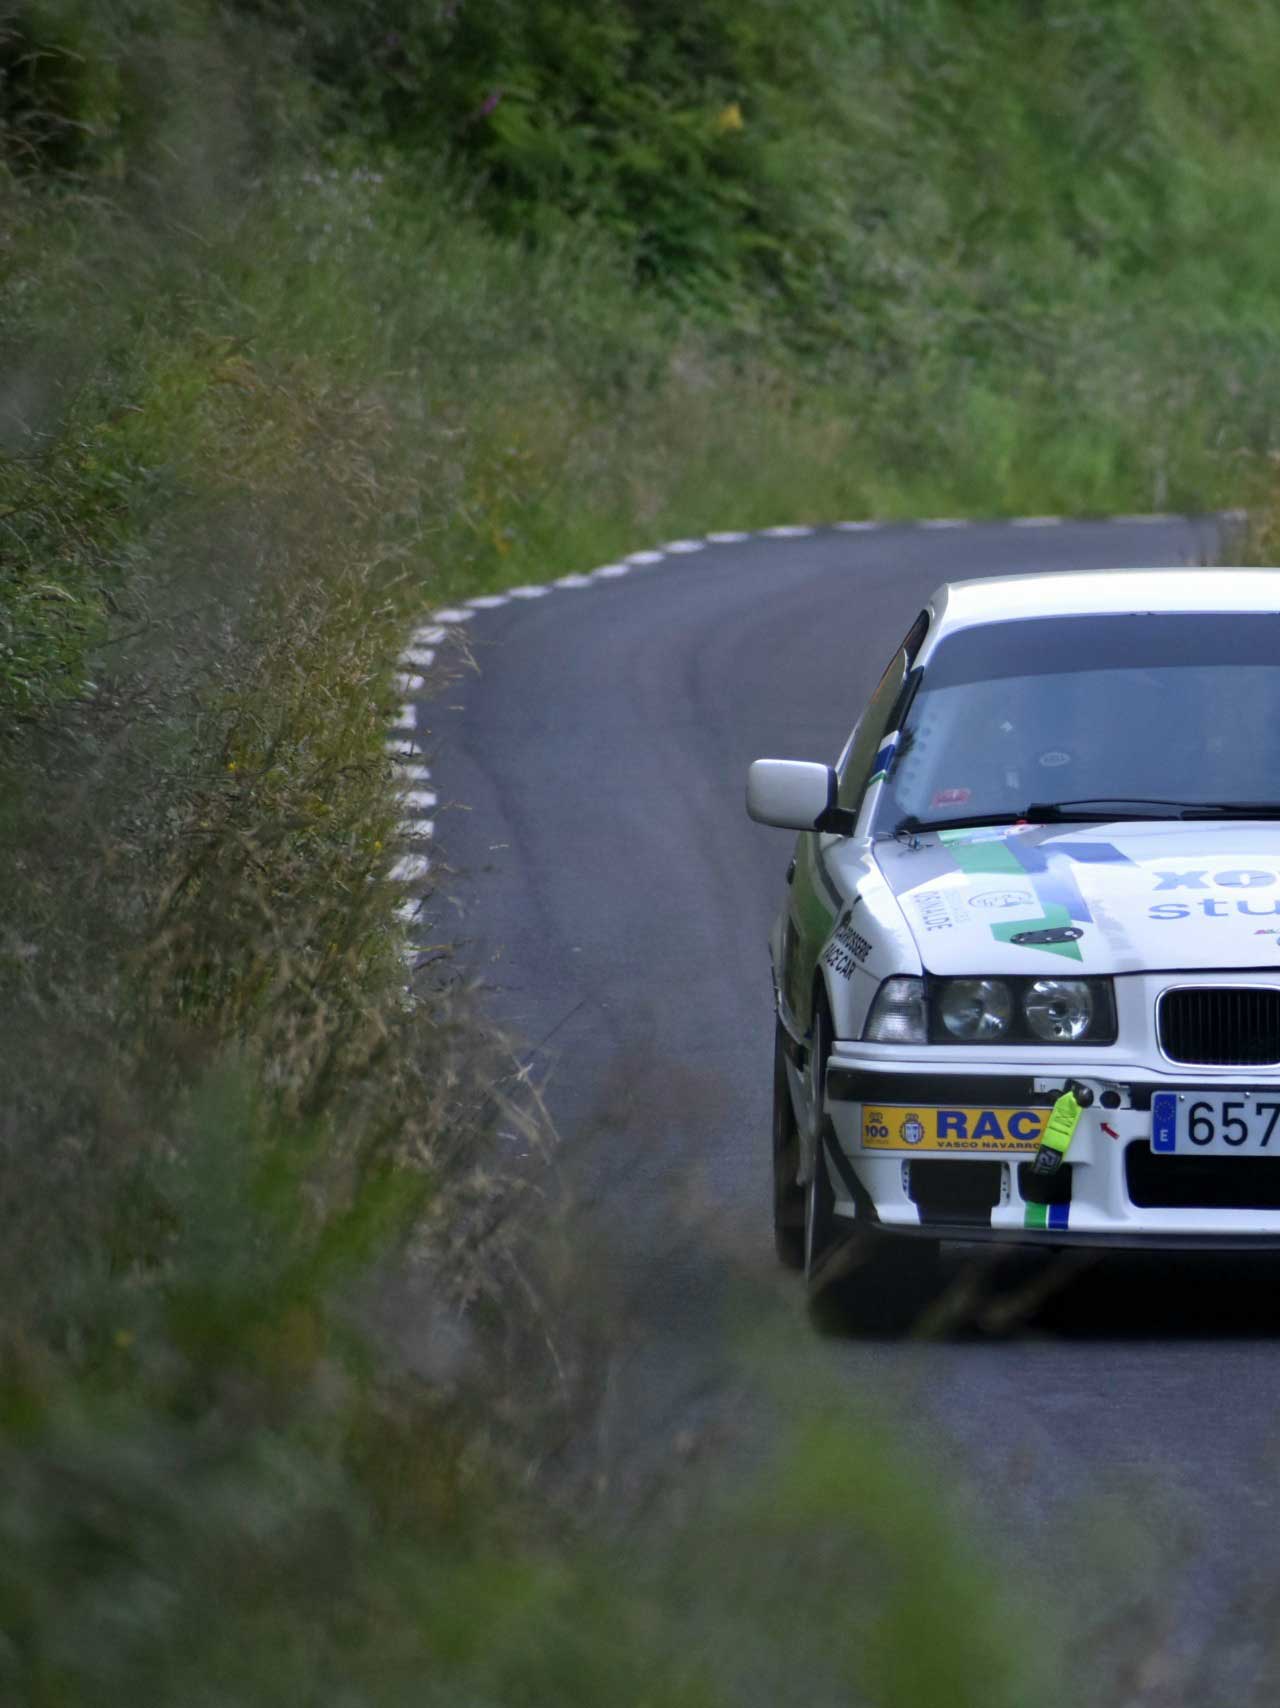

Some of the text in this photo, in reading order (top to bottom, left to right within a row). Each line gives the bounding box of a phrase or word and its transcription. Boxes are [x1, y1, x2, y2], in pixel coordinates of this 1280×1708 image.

[835, 955, 856, 981] CAR
[865, 1125, 889, 1139] 100
[936, 1111, 1041, 1141] RAC
[1159, 1129, 1169, 1142] E
[936, 1141, 978, 1149] VASCO
